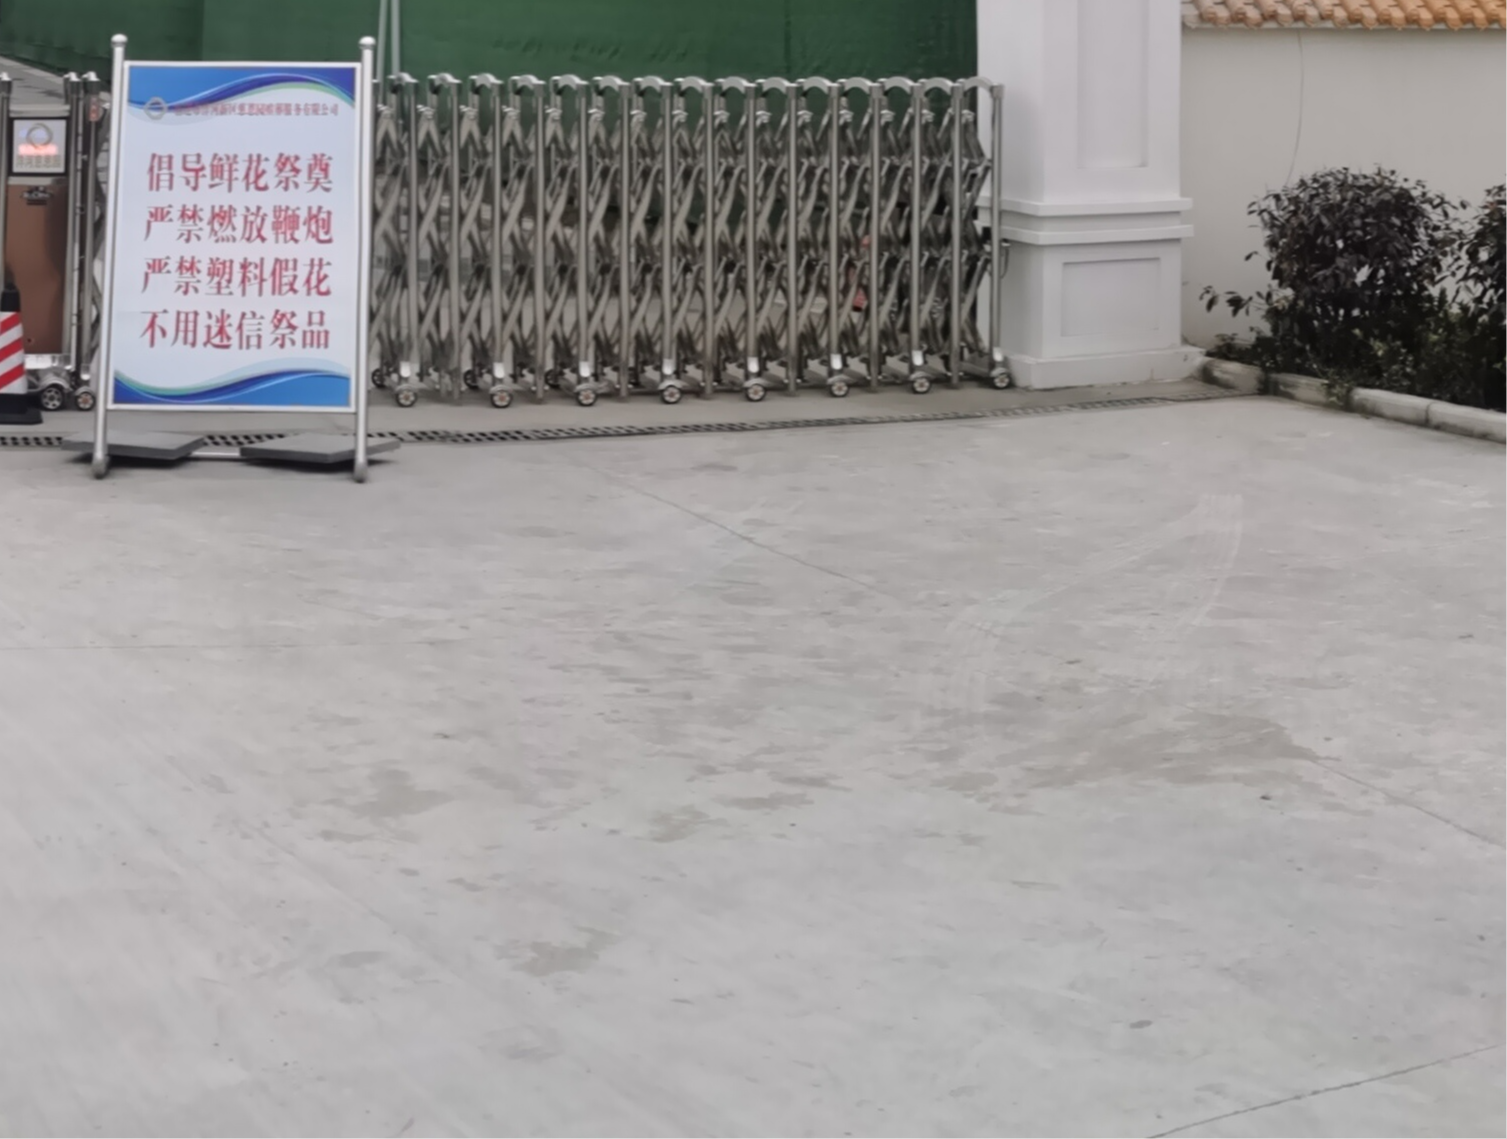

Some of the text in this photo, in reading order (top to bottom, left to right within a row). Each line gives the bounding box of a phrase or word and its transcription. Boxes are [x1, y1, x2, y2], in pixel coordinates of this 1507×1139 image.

[147, 152, 333, 193] 倡导鲜花祭奠
[144, 204, 334, 245] 严禁燃放鞭炮
[141, 255, 333, 298] 严禁塑料假花
[139, 308, 330, 351] 不用迷信祭品
